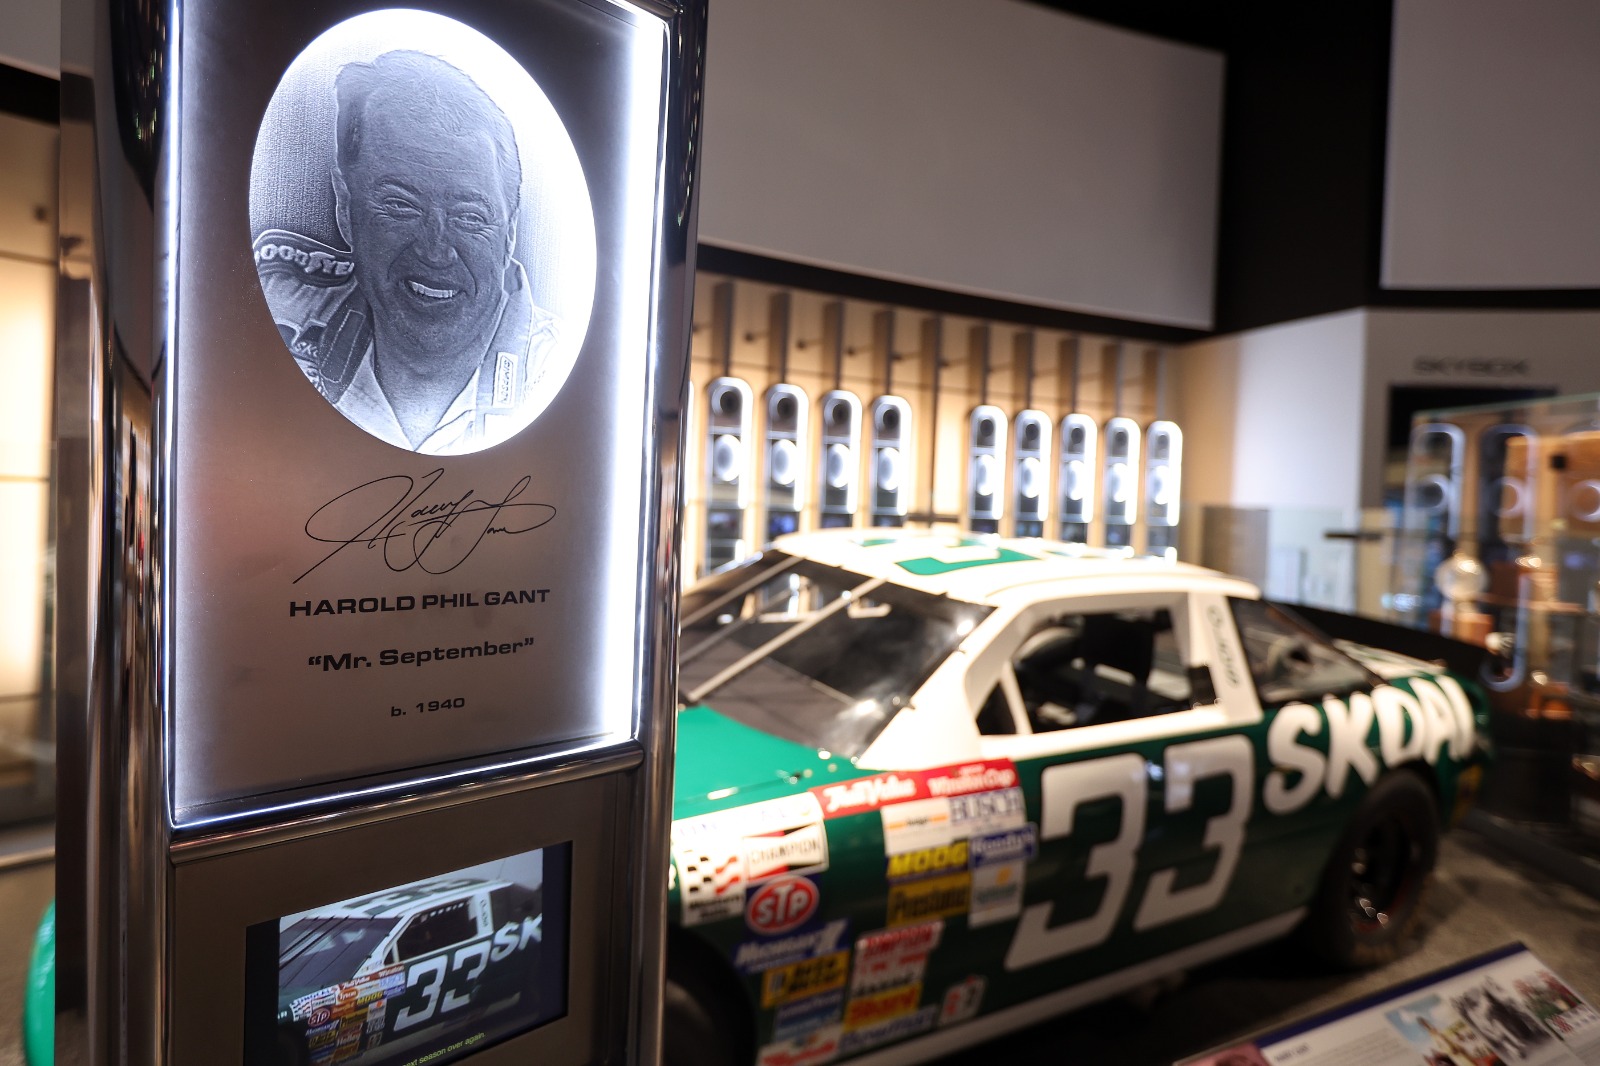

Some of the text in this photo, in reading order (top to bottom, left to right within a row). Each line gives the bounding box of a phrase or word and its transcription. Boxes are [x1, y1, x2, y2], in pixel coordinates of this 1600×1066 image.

[254, 243, 354, 276] OODYE
[290, 589, 550, 617] HAROLD PHIL GANT
[379, 637, 534, 667] September”
[391, 697, 465, 717] b. 1940
[889, 841, 967, 876] MOOG
[1004, 734, 1254, 971] 33
[756, 884, 810, 925] STP
[393, 940, 493, 1031] 33
[310, 1011, 327, 1025] STP
[419, 1048, 446, 1064] season
[447, 1041, 463, 1052] over
